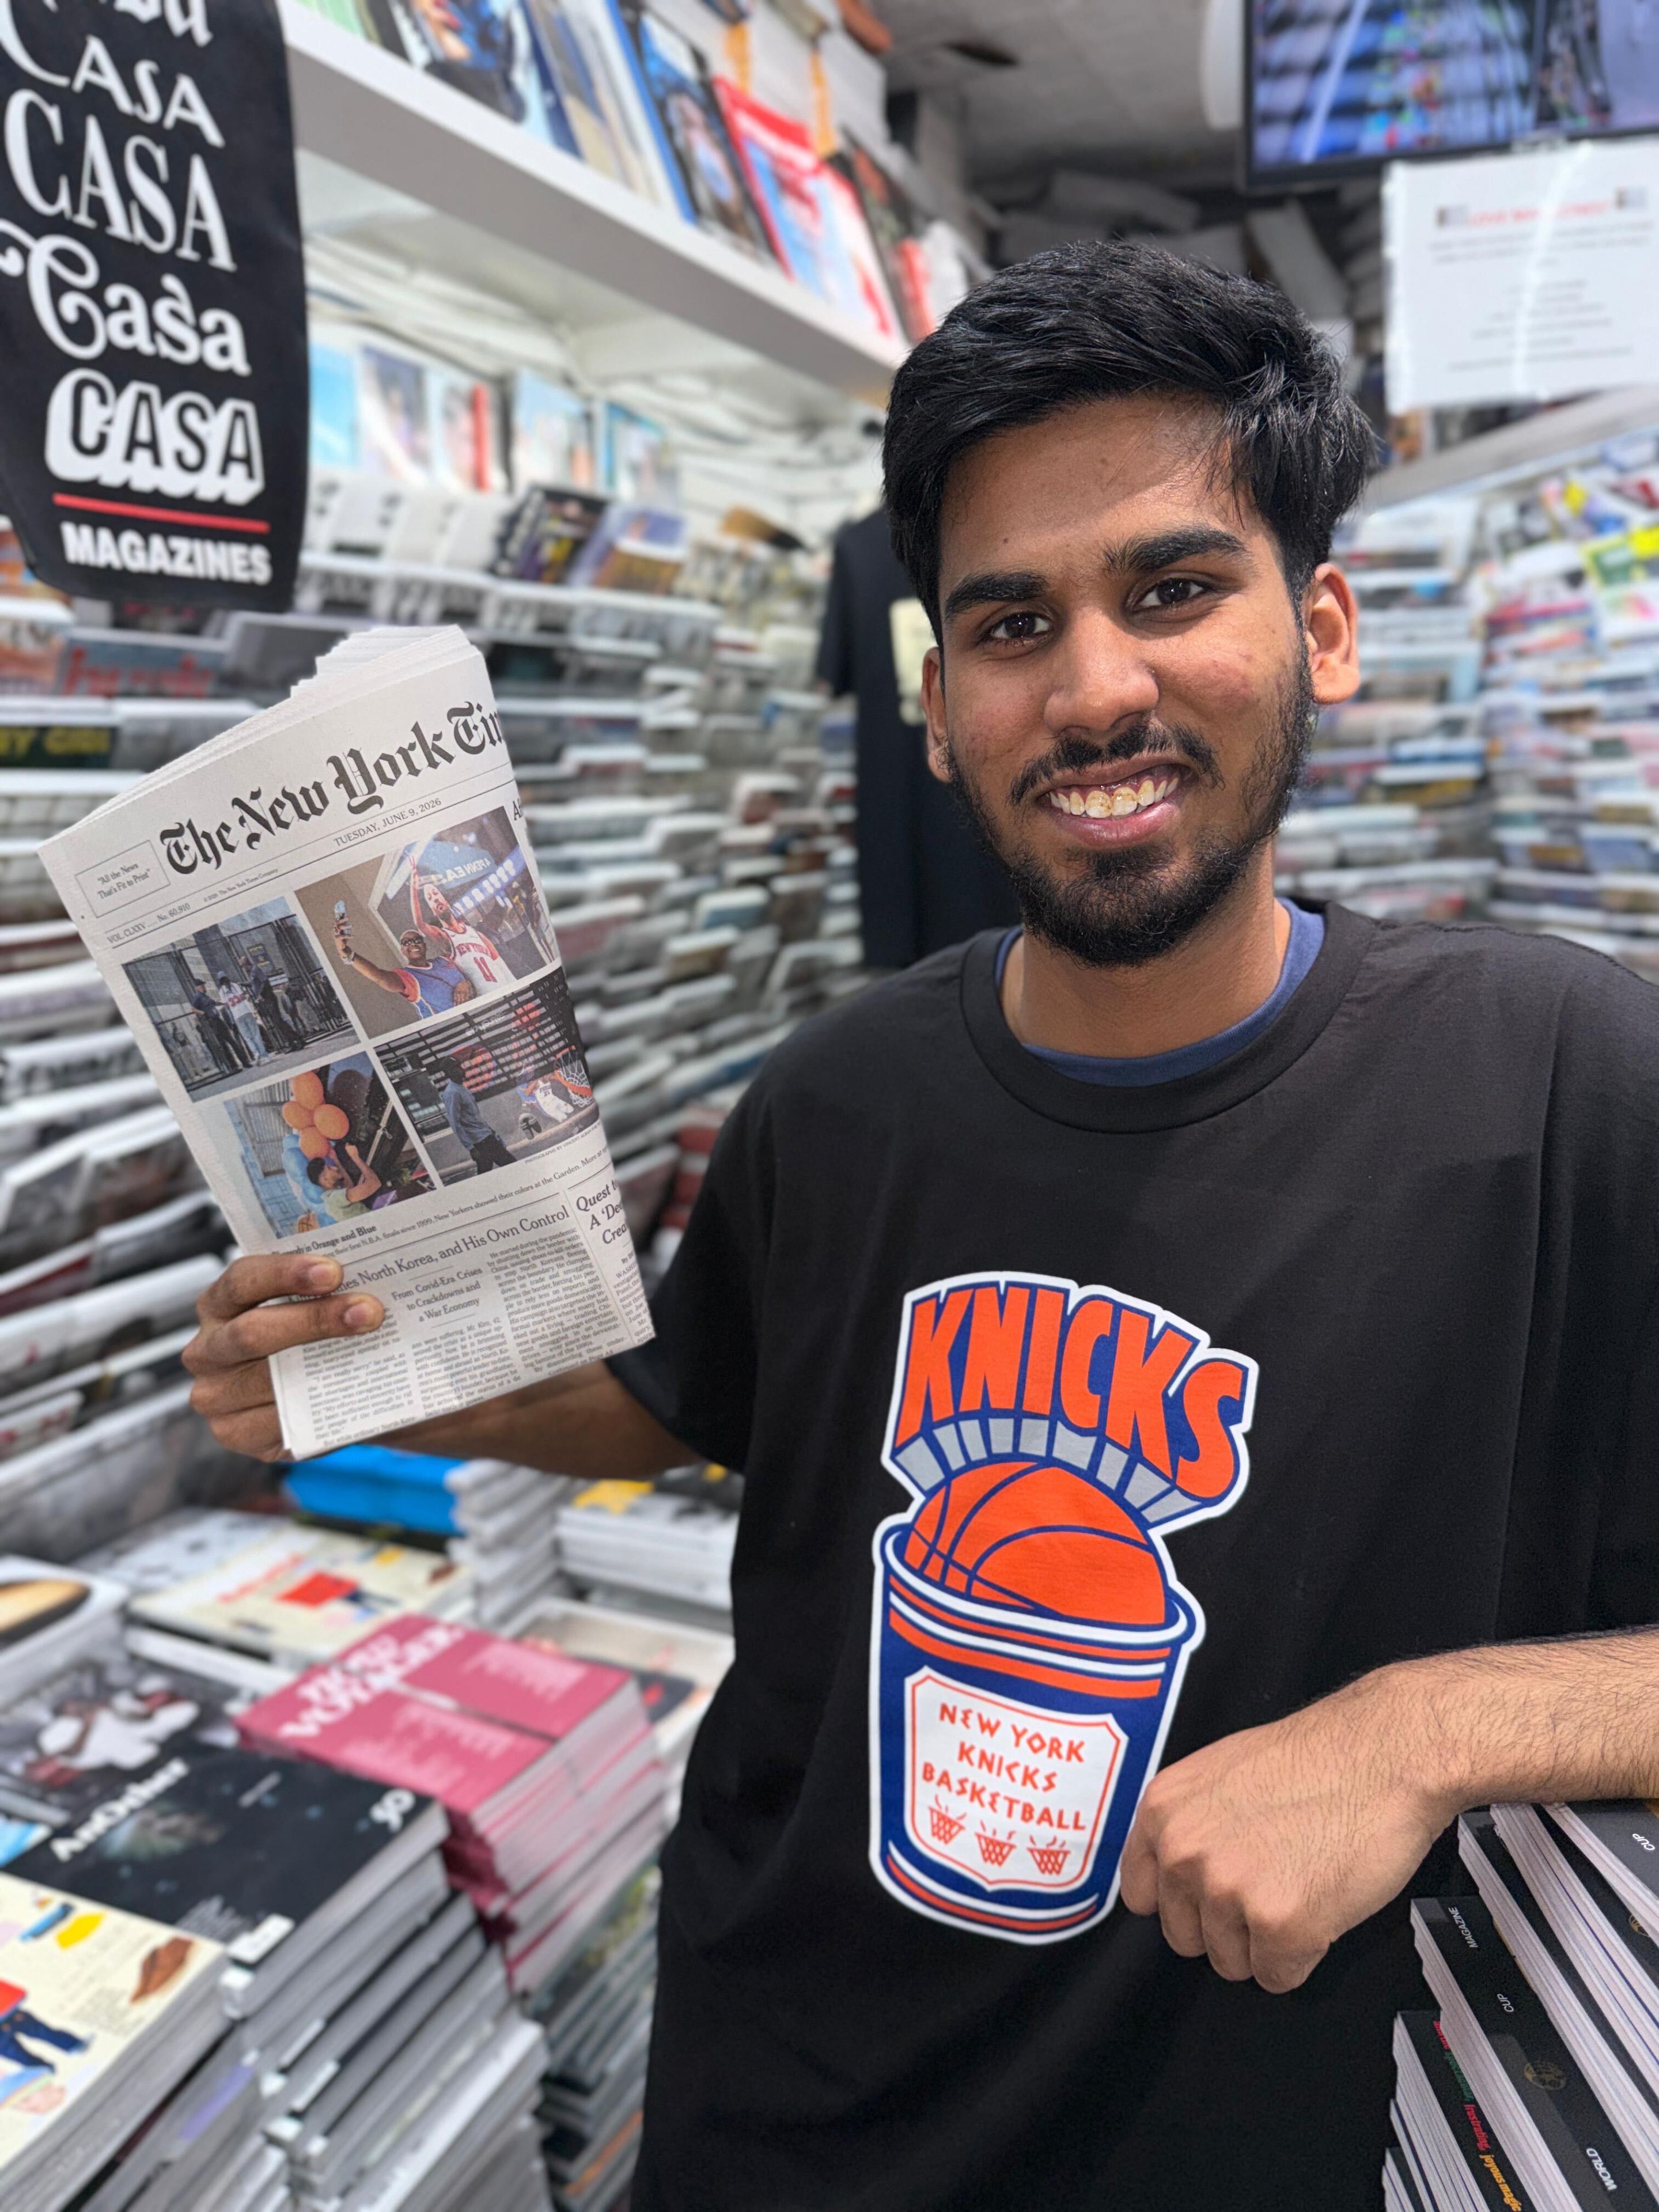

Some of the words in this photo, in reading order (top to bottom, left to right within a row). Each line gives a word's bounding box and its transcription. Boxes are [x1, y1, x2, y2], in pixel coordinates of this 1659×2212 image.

[4, 88, 237, 272] CASA
[45, 368, 265, 505] CASA
[60, 520, 272, 585] MAGAZINES
[160, 818, 239, 874] The
[232, 781, 330, 850] New
[327, 721, 456, 815] York
[334, 823, 381, 846] TUESDAY,
[383, 810, 407, 827] JUNE
[408, 808, 419, 818] 9,
[419, 798, 442, 812] 2026
[120, 862, 138, 874] News
[473, 957, 498, 983] 11
[382, 1229, 400, 1238] finals
[400, 1225, 415, 1233] since
[416, 1218, 434, 1229] 1999,
[434, 1212, 449, 1222] New
[449, 1203, 474, 1216] Yorkers
[475, 1196, 498, 1209] showed
[498, 1189, 514, 1200] their
[514, 1184, 534, 1195] colors
[541, 1176, 553, 1185] the
[554, 1165, 582, 1180] Garden.
[582, 1156, 597, 1167] More
[576, 1184, 611, 1212] Quest
[312, 1238, 340, 1249] Orange
[341, 1230, 356, 1241] and
[356, 1225, 377, 1236] Blue
[590, 1214, 601, 1230] A
[358, 1259, 396, 1284] North
[395, 1254, 438, 1272] Korea,
[440, 1241, 463, 1259] and
[463, 1234, 487, 1251] His
[487, 1226, 521, 1242] Own
[519, 1205, 570, 1232] Control
[519, 1240, 539, 1249] during
[548, 1228, 577, 1241] pandemic
[546, 1240, 565, 1248] border
[566, 1233, 580, 1242] with
[519, 1262, 537, 1272] North
[529, 1277, 546, 1285] trade
[548, 1271, 559, 1279] and
[563, 1263, 592, 1275] smuggling
[391, 1289, 415, 1301] From
[415, 1277, 456, 1294] Covid-Era
[456, 1267, 483, 1280] Crises
[407, 1300, 416, 1310] to
[415, 1287, 465, 1308] Crackdowns
[465, 1282, 481, 1294] and
[546, 1296, 563, 1306] goods
[563, 1283, 601, 1299] domestically
[562, 1281, 585, 1291] imports
[588, 1275, 599, 1283] and
[425, 1307, 442, 1320] War
[442, 1297, 480, 1314] Economy
[893, 1283, 1246, 1500] KNICKS
[940, 1702, 1001, 1738] NEW
[1011, 1723, 1085, 1763] YORK
[957, 1741, 1057, 1793] KNICKS
[922, 1762, 1086, 1831] BASKETBALL
[1633, 1833, 1655, 1850] CUP
[1448, 1906, 1479, 1948] MAGAZINE
[1497, 1993, 1514, 2013] CUP
[1479, 2154, 1505, 2184] joyous
[1498, 2183, 1521, 2211] magic
[1586, 2147, 1618, 2191] WORLD
